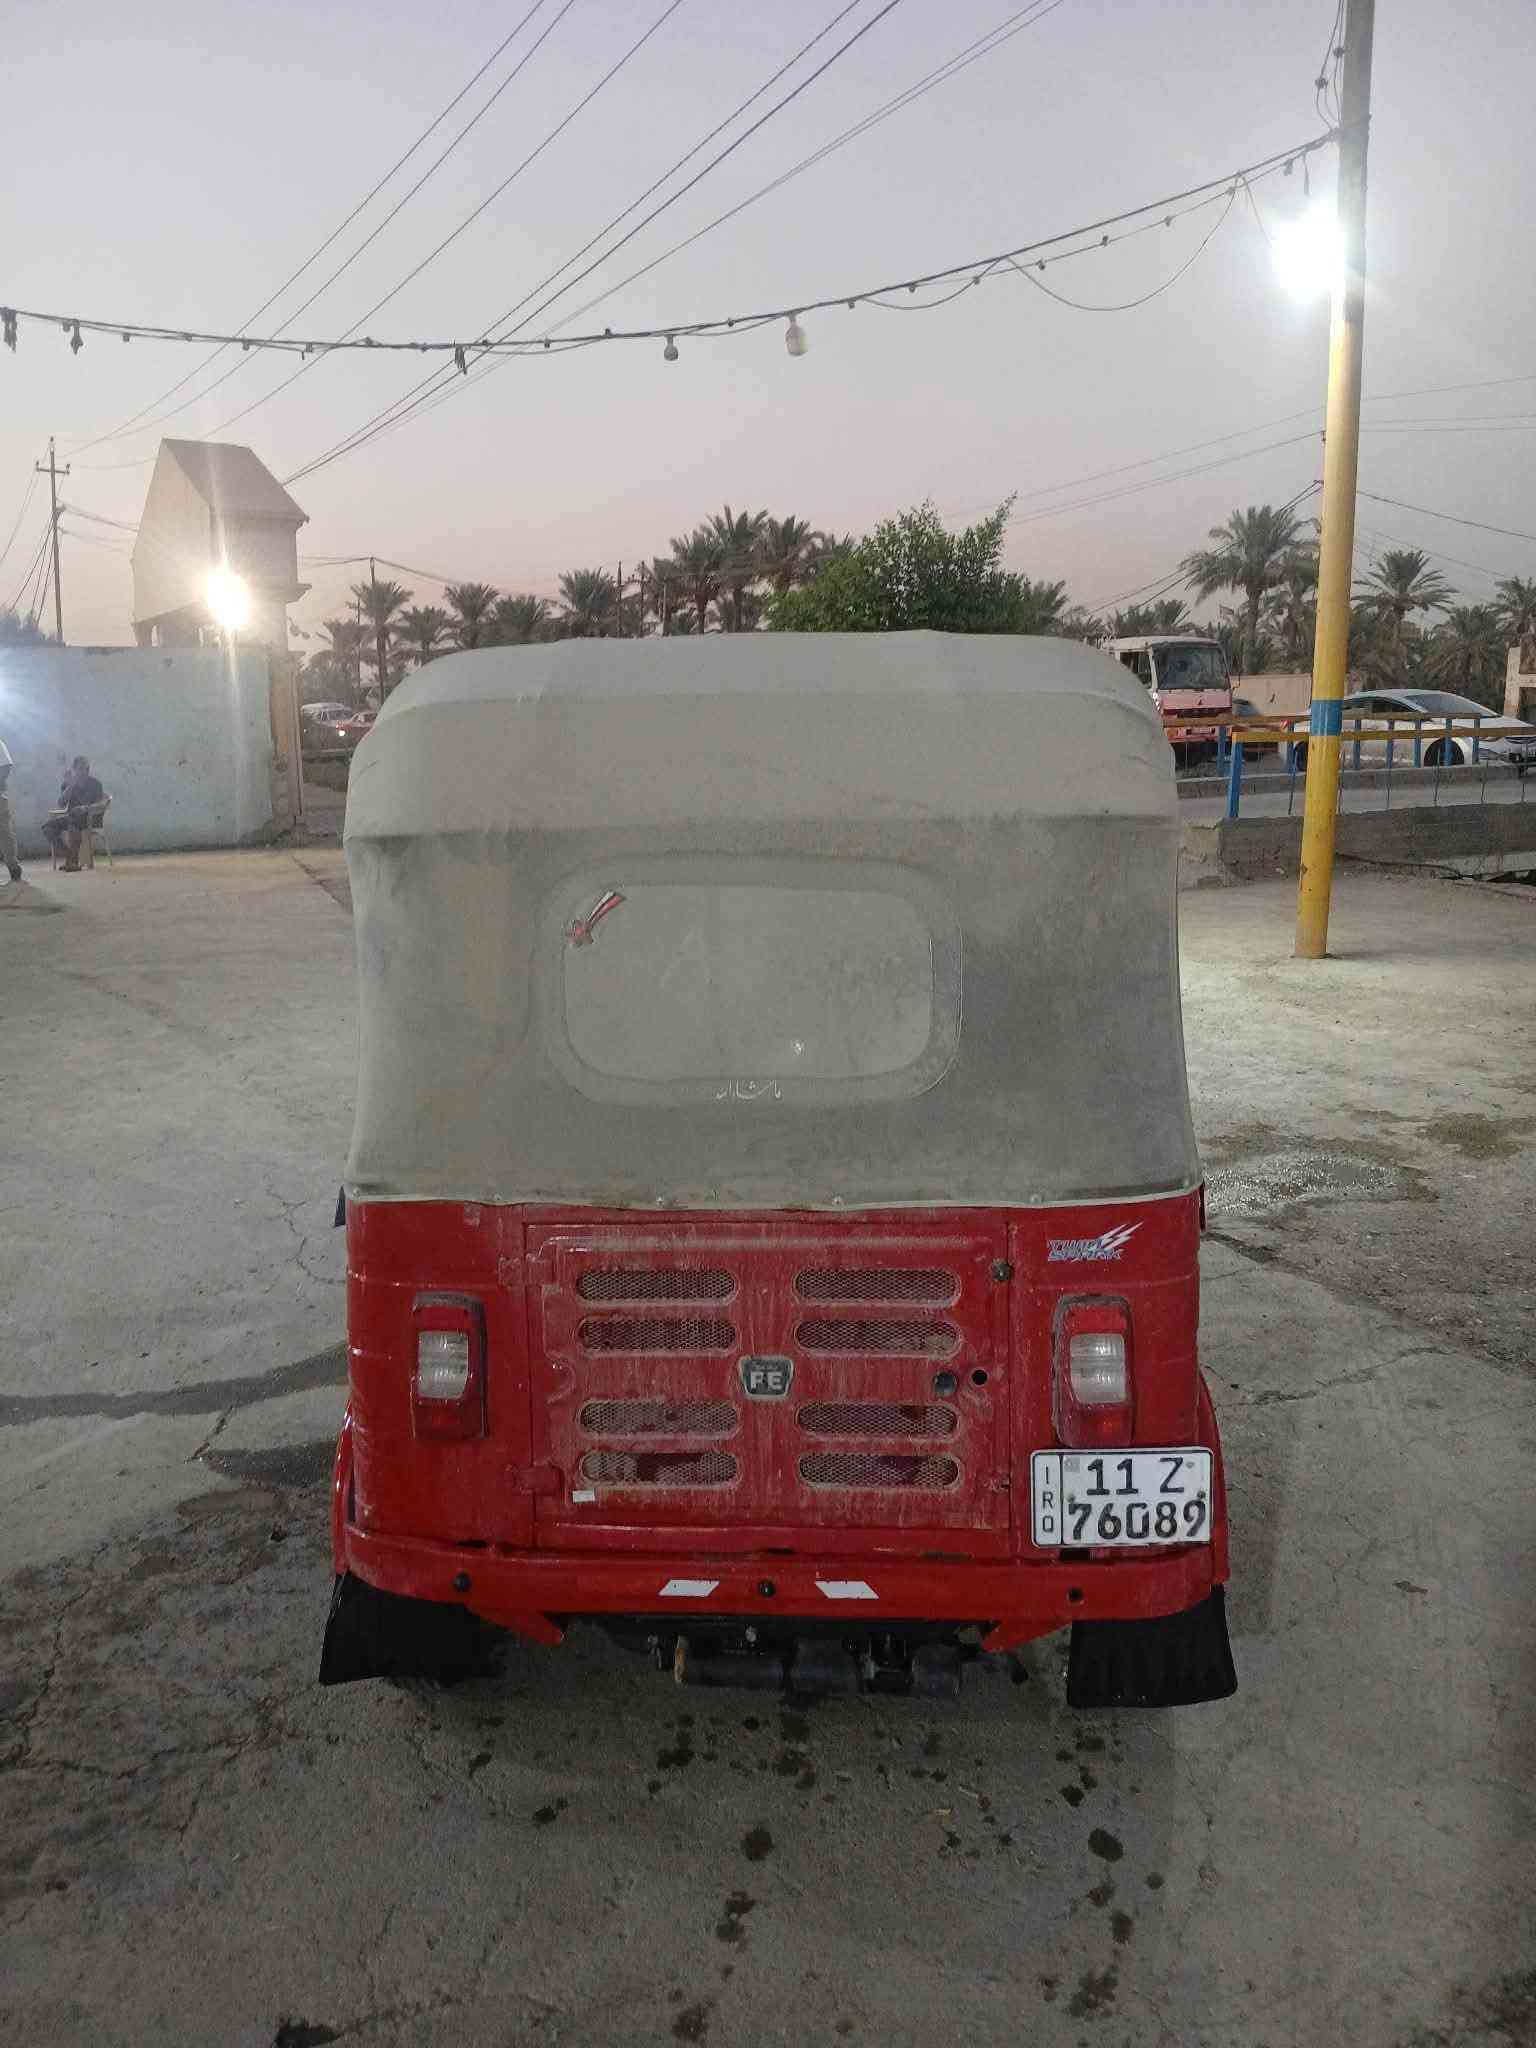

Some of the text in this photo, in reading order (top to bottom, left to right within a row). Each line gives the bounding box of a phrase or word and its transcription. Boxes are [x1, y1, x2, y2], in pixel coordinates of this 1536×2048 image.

[1086, 1457, 1185, 1496] 11 Z
[1068, 1500, 1206, 1540] 76089
